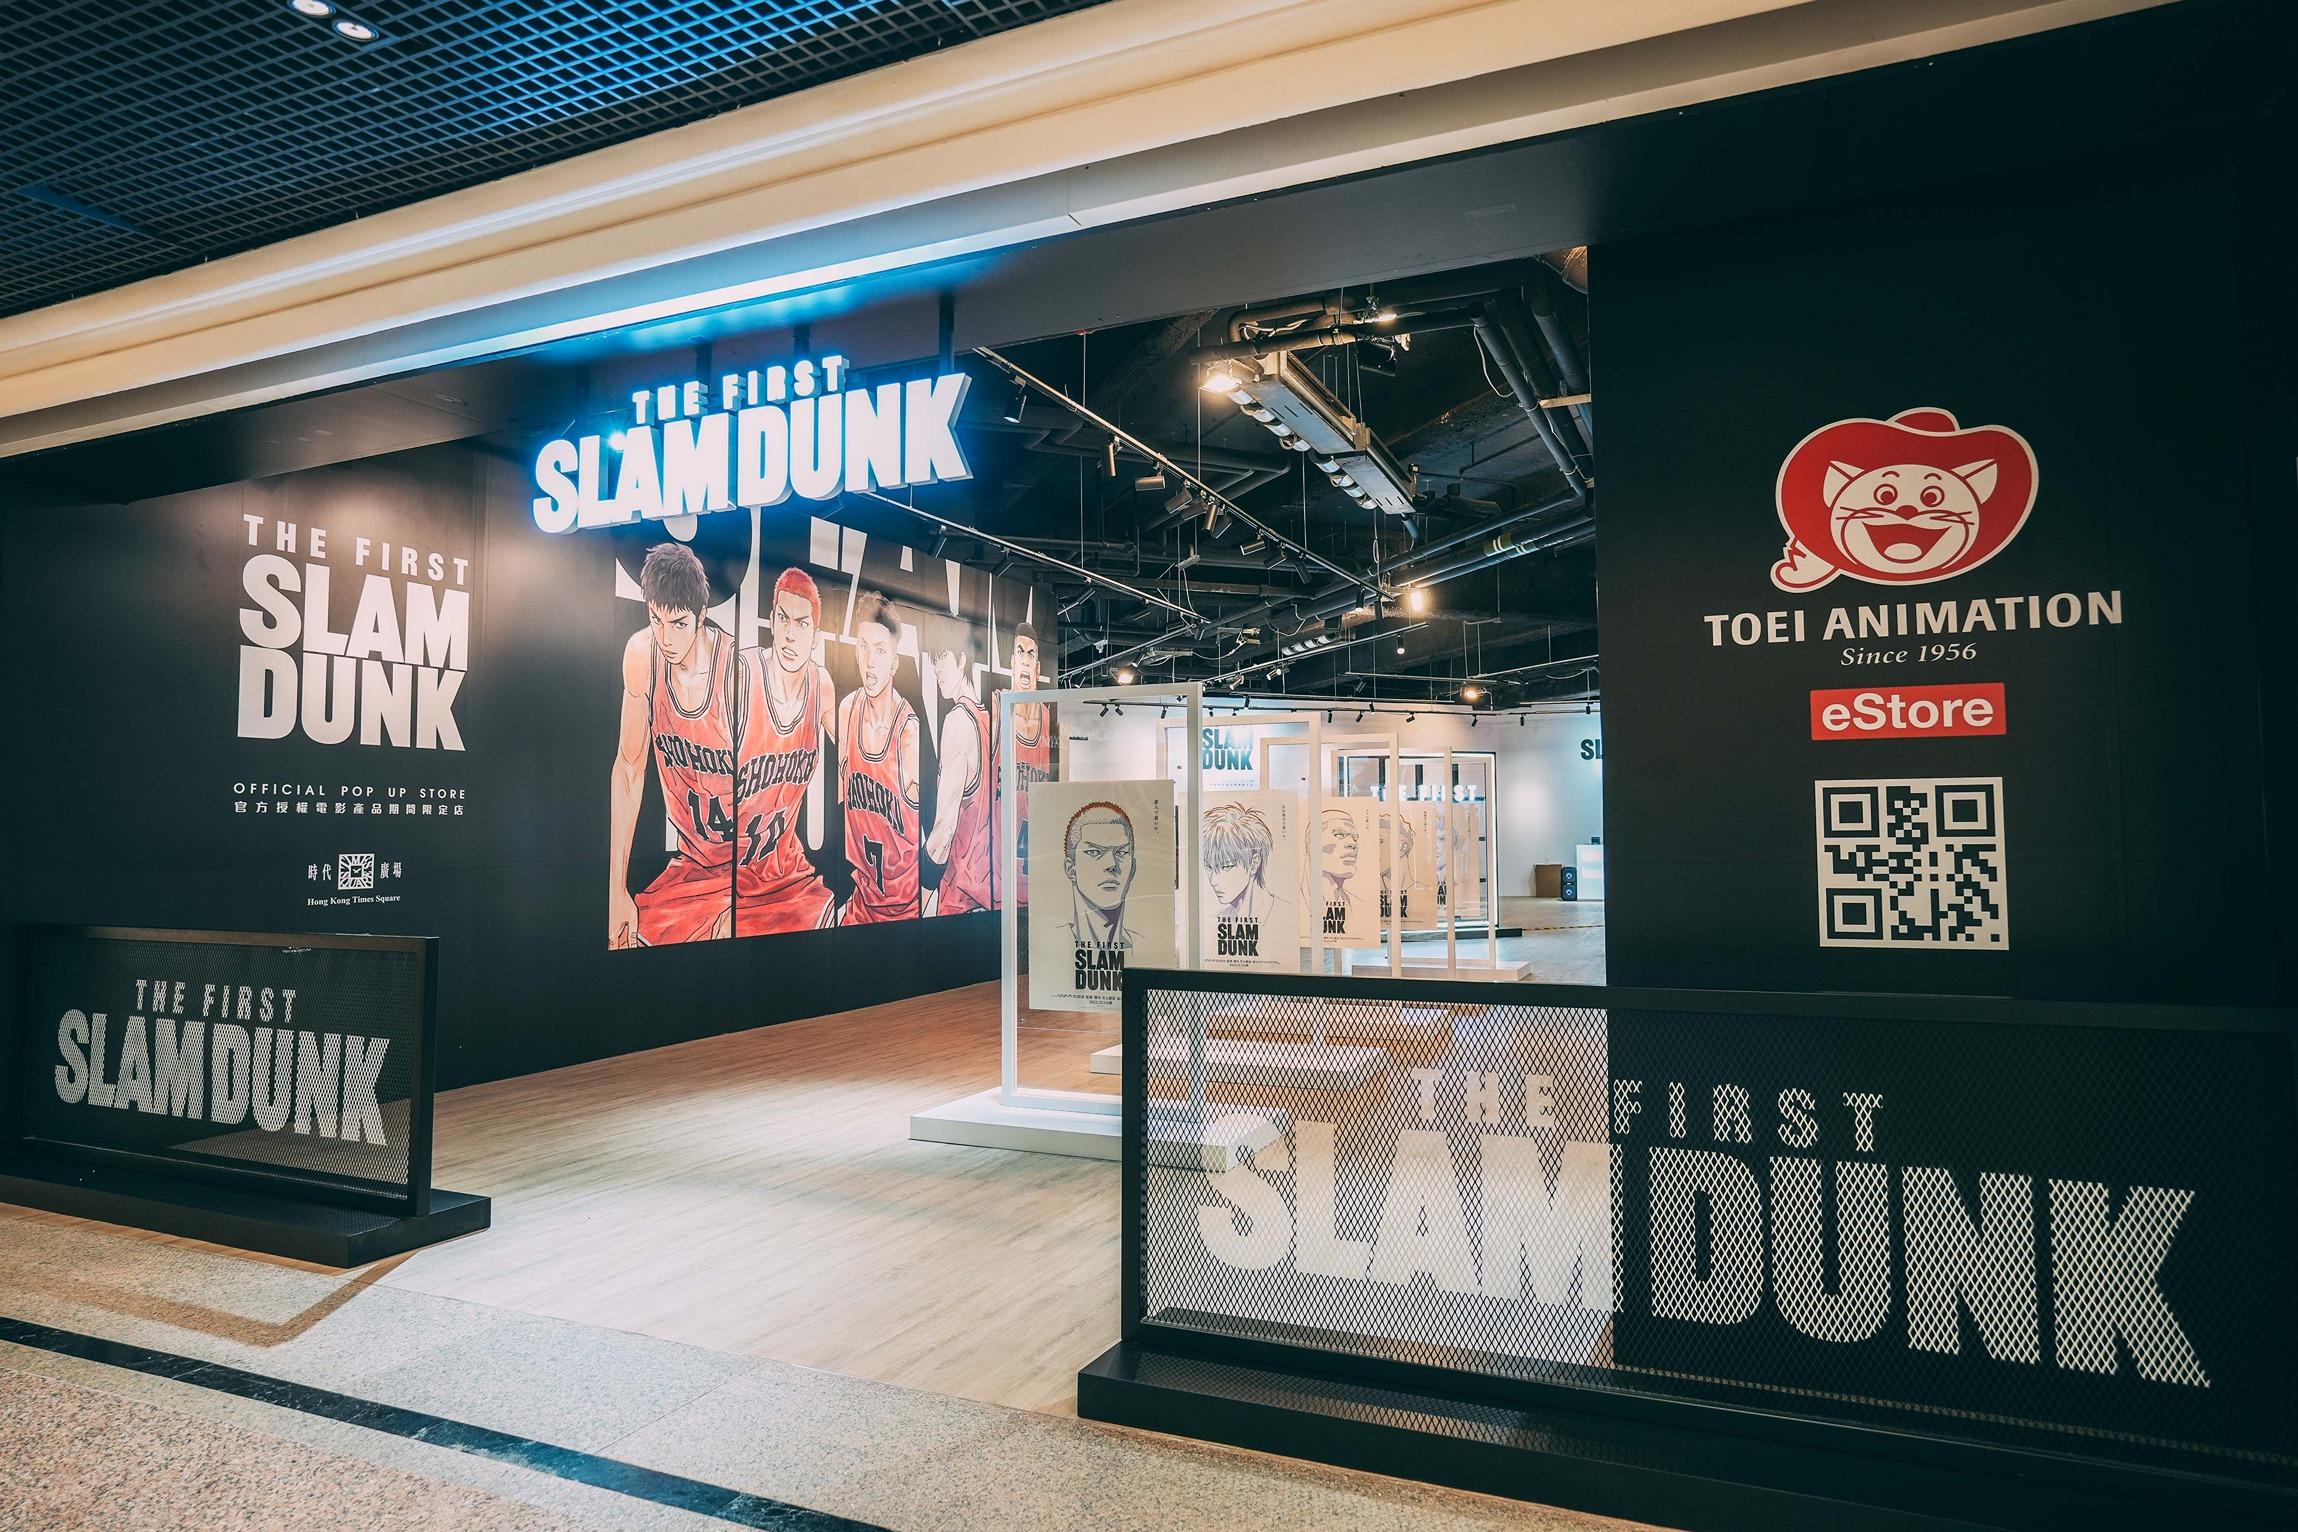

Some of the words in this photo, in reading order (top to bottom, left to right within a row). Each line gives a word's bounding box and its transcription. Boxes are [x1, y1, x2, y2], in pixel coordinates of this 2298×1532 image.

[632, 379, 706, 425] THE
[722, 354, 847, 411] FIRST
[533, 412, 736, 535] SLAM
[737, 371, 974, 508] DUNK
[243, 513, 327, 559] THE
[355, 537, 469, 585] FIRST
[239, 554, 470, 672] SLAM
[1704, 610, 1806, 647] TOEI
[1822, 590, 2123, 641] ANIMATION
[1840, 646, 1908, 667] Since
[1918, 642, 1978, 663] 1956
[237, 644, 466, 752] DUNK
[1821, 691, 1995, 732] eStore
[655, 733, 735, 776] SHOHOK
[1202, 749, 1253, 770] DUNK
[233, 782, 326, 796] OFFICIAL
[341, 786, 374, 797] POP
[388, 787, 407, 798] UP
[419, 788, 466, 800] STORE
[687, 788, 735, 842] 14
[739, 808, 787, 866] 10
[307, 863, 333, 881] 時代
[862, 834, 886, 897] 7
[307, 898, 329, 907] Hong
[330, 896, 351, 905] Kong
[352, 895, 374, 904] Times
[375, 894, 401, 904] Square
[1074, 940, 1092, 949] THE
[1096, 941, 1125, 950] FIRST
[1217, 923, 1259, 940] SLAM
[1217, 940, 1259, 957] DUNK
[1074, 949, 1125, 971] SLAM
[1074, 969, 1123, 992] DUNK
[135, 979, 186, 1015] THE
[202, 984, 297, 1024] FIRST
[54, 1008, 206, 1121] SLAM
[210, 1022, 390, 1147] DUNK
[1410, 1067, 1555, 1128] THE
[1612, 1079, 1884, 1153] FIRST
[1199, 1112, 1625, 1314] SLAM
[1648, 1145, 2211, 1389] DUNK
